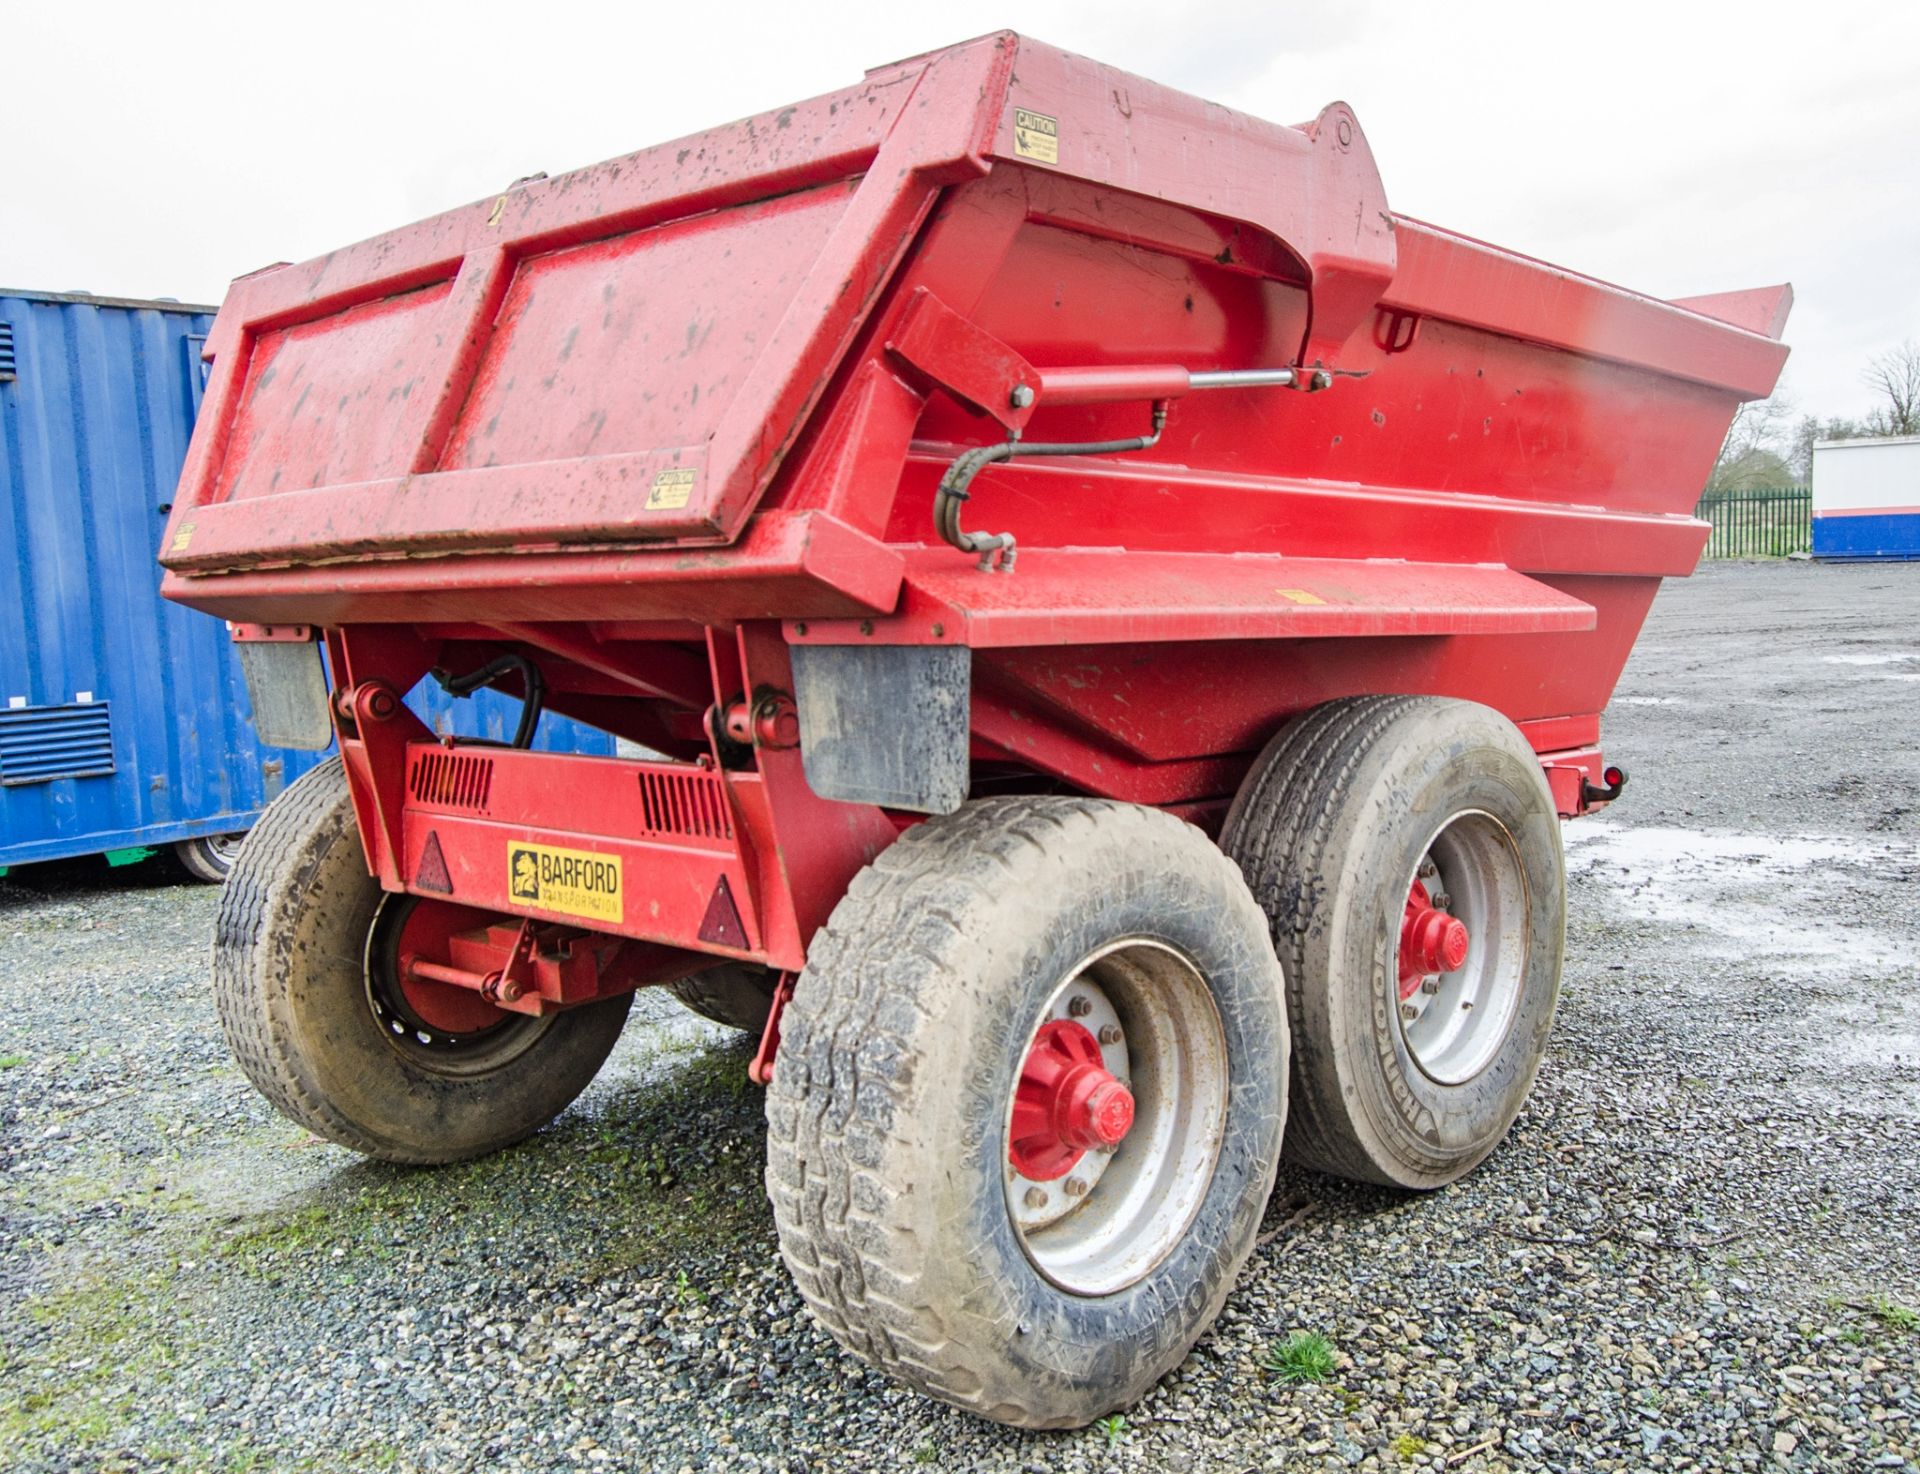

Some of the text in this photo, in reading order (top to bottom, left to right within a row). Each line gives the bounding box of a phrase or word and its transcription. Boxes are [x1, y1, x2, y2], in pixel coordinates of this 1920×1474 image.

[1017, 111, 1056, 136] CAUTION
[541, 853, 617, 894] BARFORD
[542, 887, 618, 914] TRANSPORTATION
